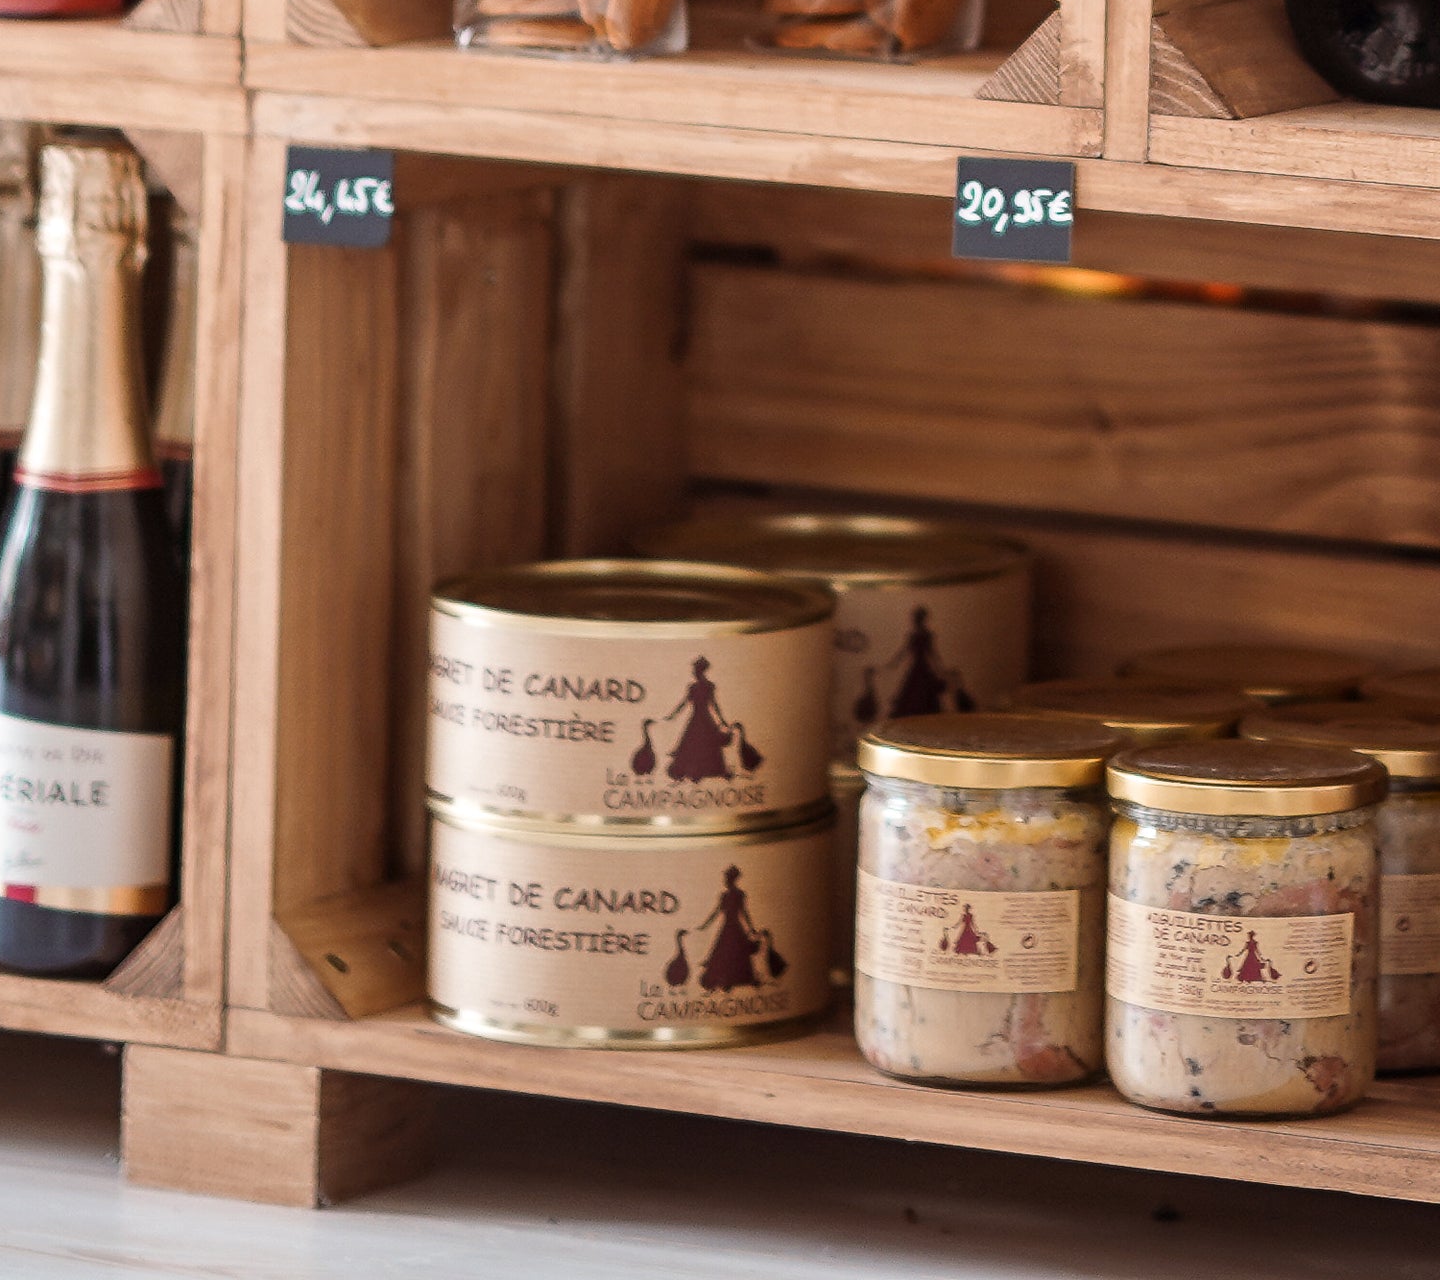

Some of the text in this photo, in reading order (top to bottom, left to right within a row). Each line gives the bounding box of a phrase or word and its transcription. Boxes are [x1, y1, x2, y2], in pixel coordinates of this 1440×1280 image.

[284, 170, 394, 225] 24,45€
[958, 180, 1074, 233] 20,95€
[524, 675, 646, 704] CANARD
[472, 708, 617, 743] FORESTIÈRE
[603, 786, 765, 810] CAMPAGNOISE
[508, 881, 681, 915] DE CANARD
[495, 918, 651, 955] FORESTIÈRE
[1173, 930, 1231, 947] CANARD
